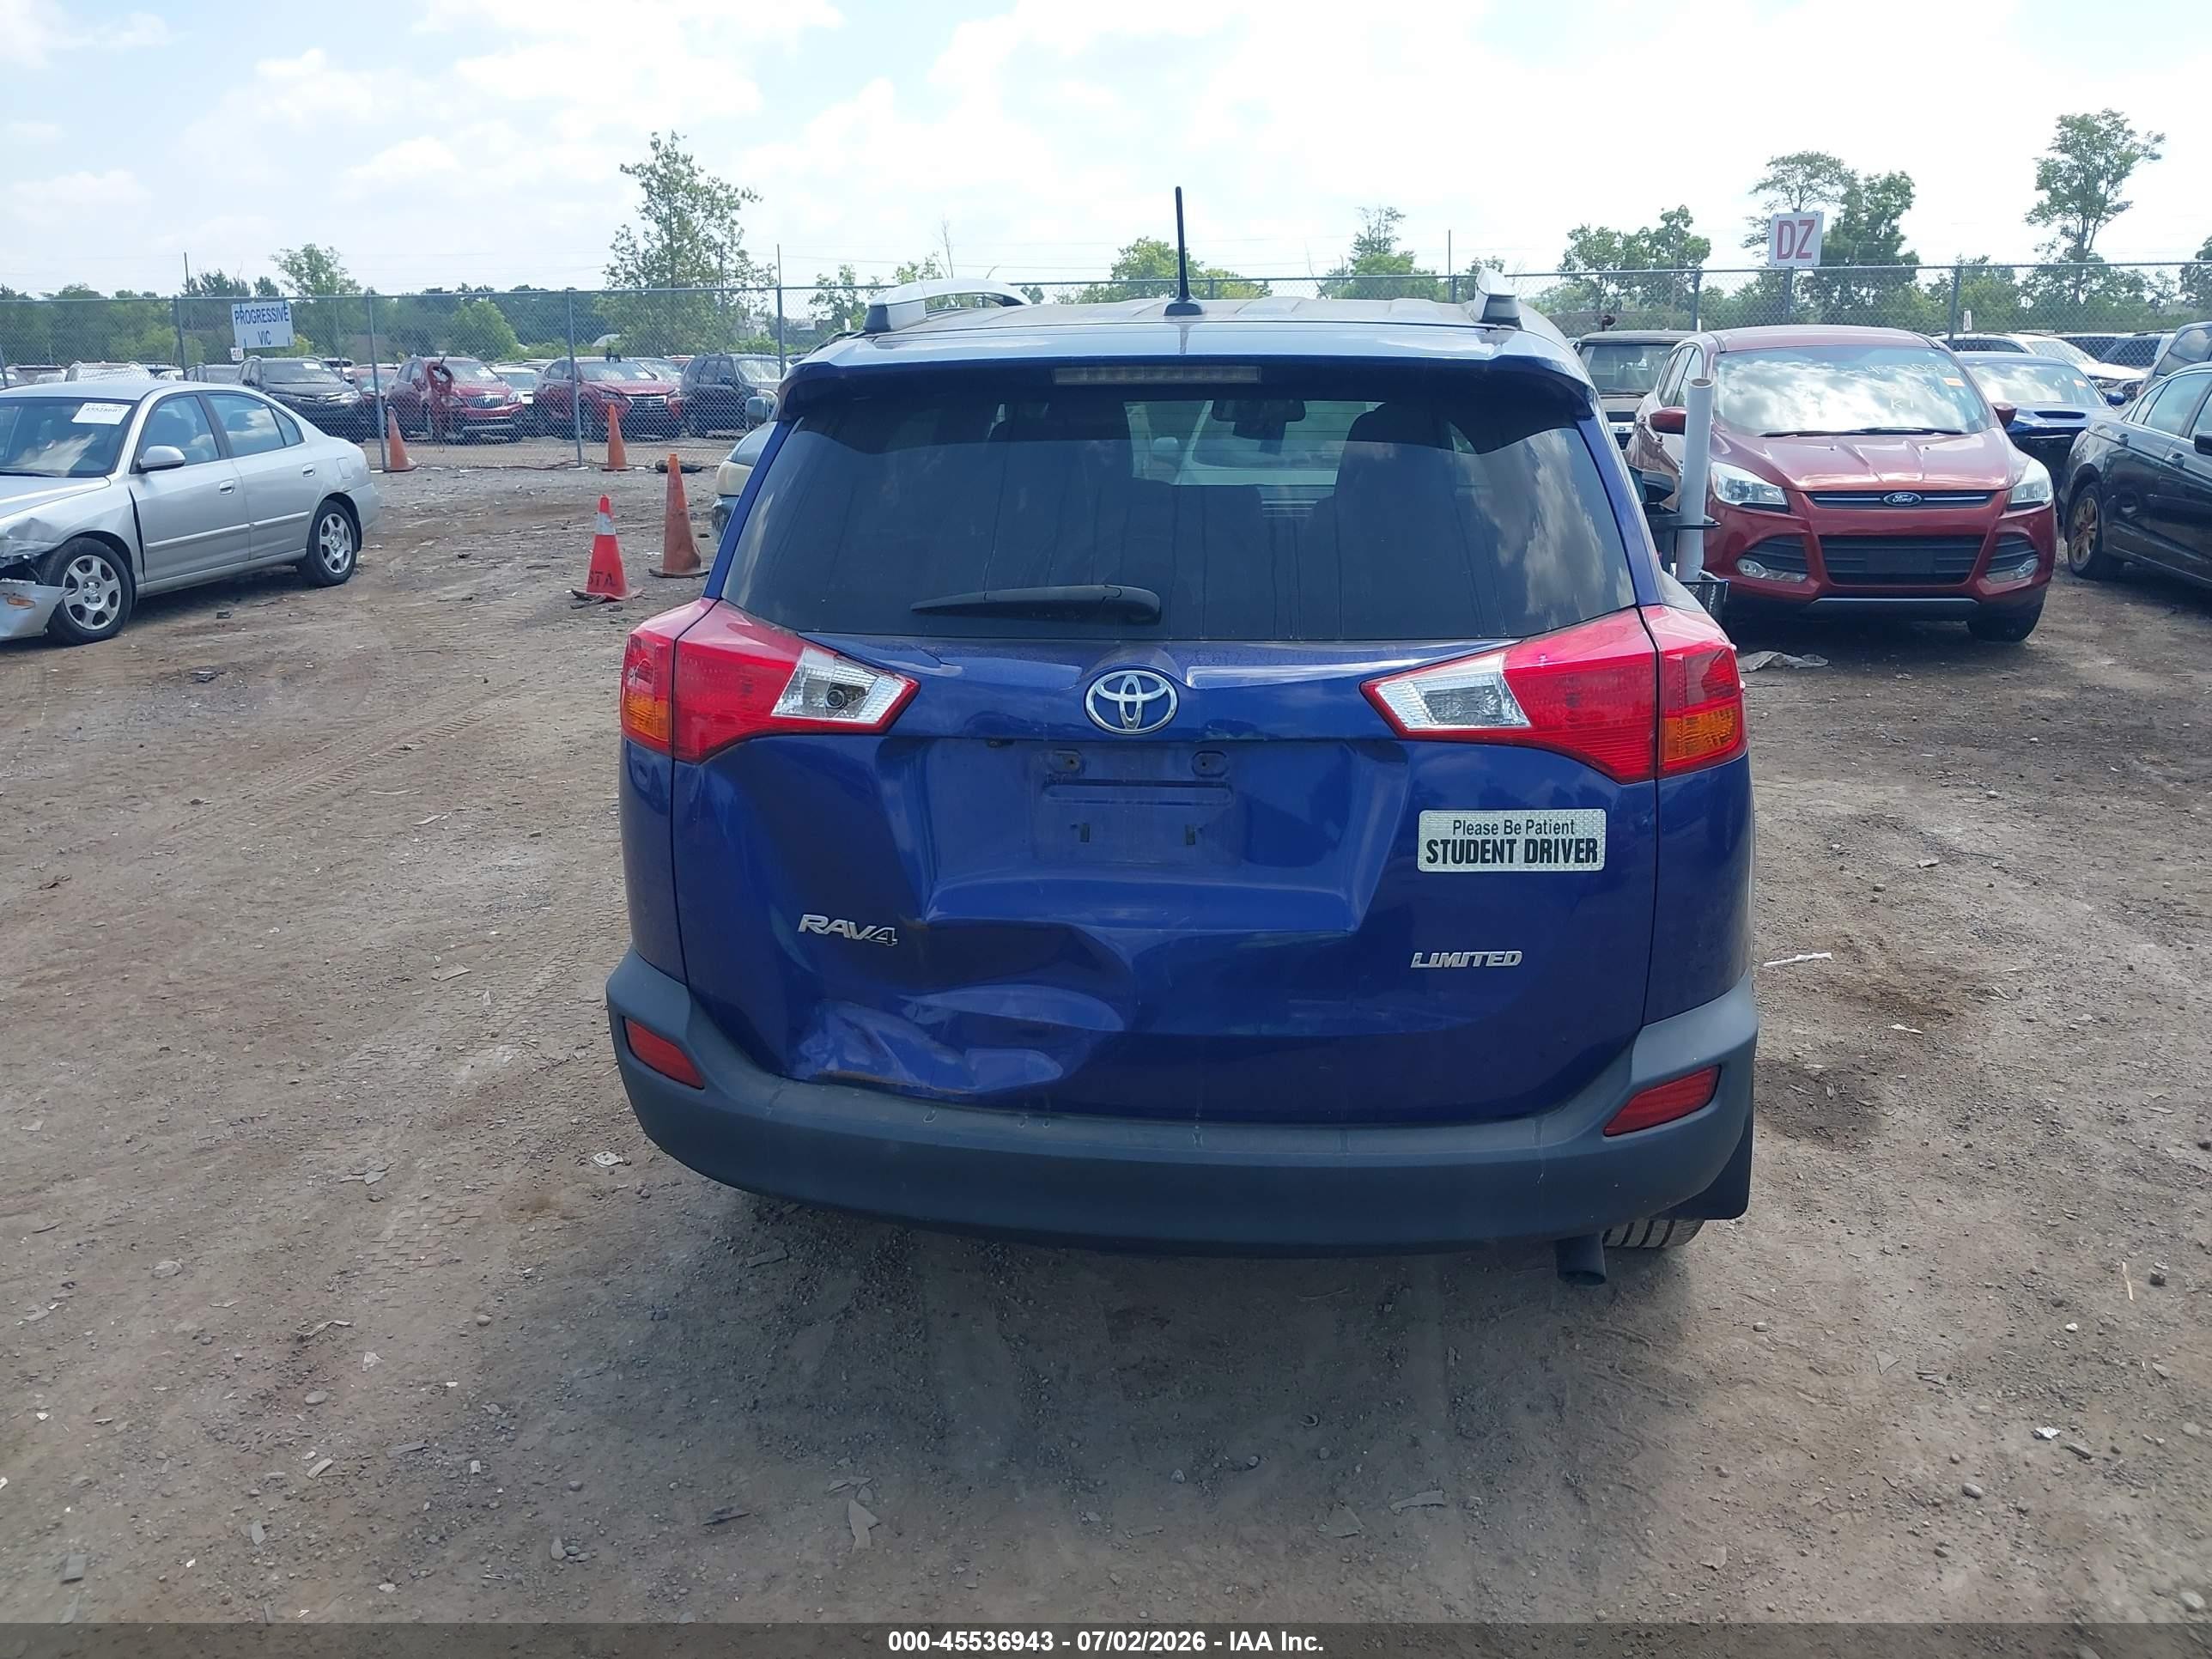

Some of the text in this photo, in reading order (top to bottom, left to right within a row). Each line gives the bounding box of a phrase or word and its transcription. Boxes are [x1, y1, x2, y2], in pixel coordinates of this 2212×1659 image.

[1777, 219, 1815, 260] DZ
[234, 307, 289, 325] PROGRESSIVE
[258, 330, 271, 345] VIC
[1892, 494, 1914, 503] Ford
[1452, 819, 1576, 836] Please Be Patient
[1425, 837, 1598, 865] STUDENT DRIVER
[798, 914, 898, 946] RAV4
[1410, 950, 1523, 969] LIMITED
